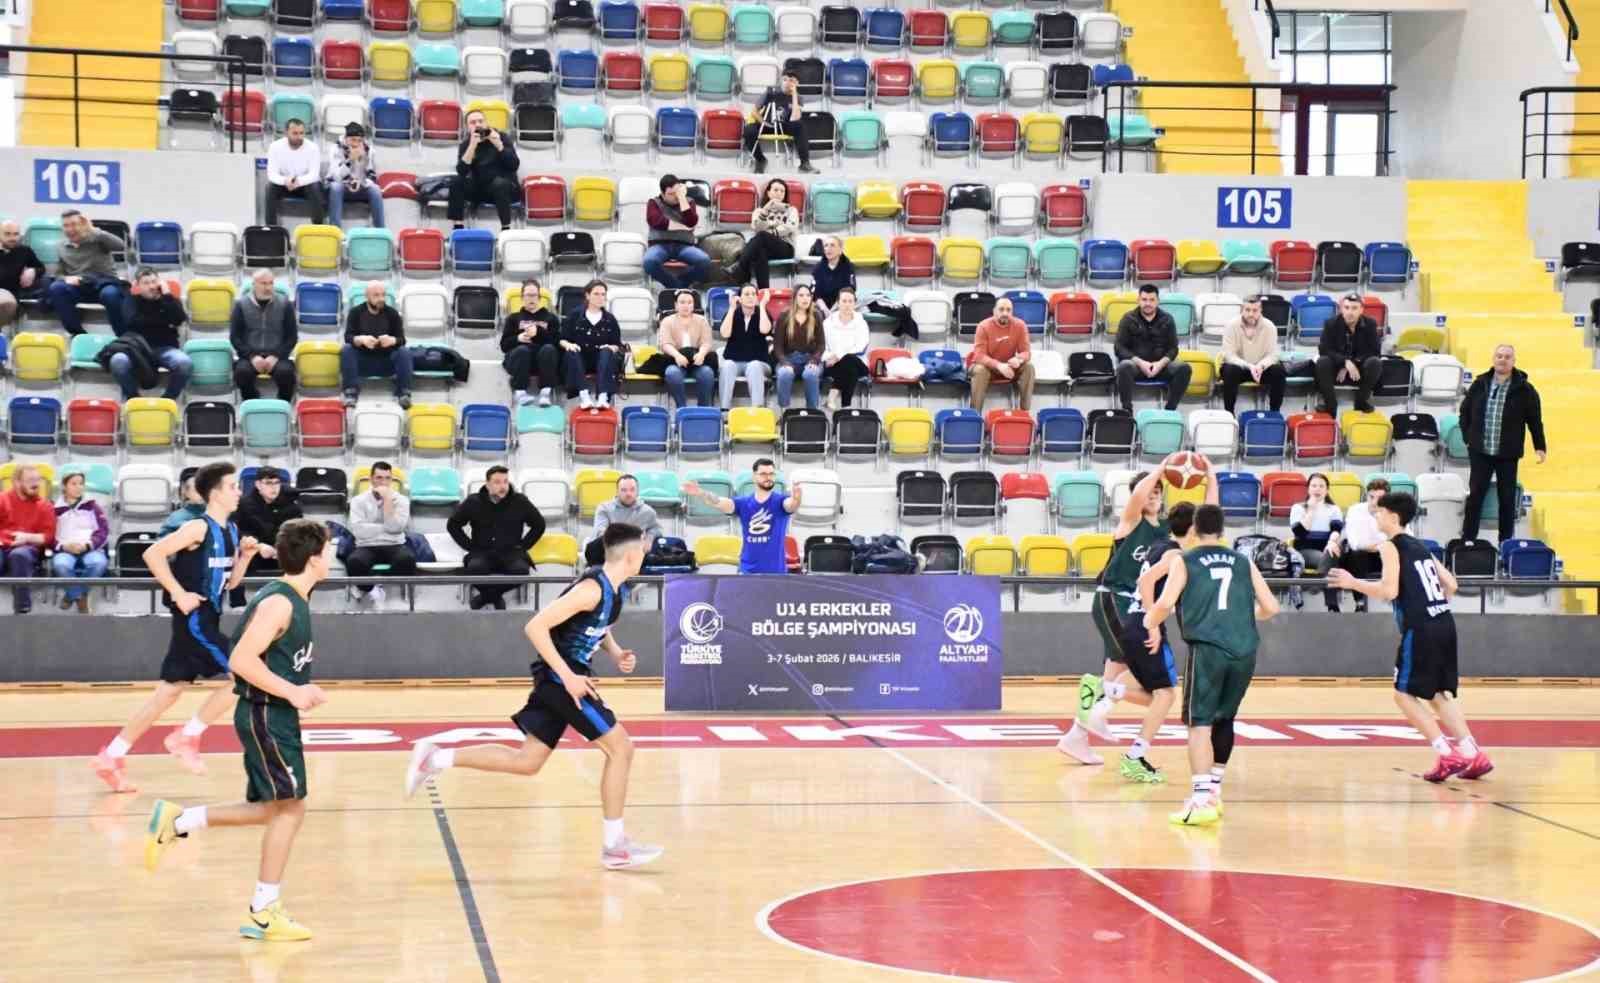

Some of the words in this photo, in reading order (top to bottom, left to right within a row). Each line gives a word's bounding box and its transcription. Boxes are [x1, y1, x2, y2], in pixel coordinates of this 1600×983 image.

[41, 163, 110, 201] 105
[1224, 189, 1282, 224] 105
[1209, 567, 1233, 610] 7
[1413, 558, 1446, 602] 18
[776, 602, 808, 617] U14
[810, 602, 892, 617] ERKEKLER
[751, 618, 805, 636] BÖLGE
[807, 619, 917, 639] ŞAMPİYONASI
[767, 653, 782, 664] 3-7
[785, 653, 814, 665] Şubat
[816, 653, 840, 664] 2026
[849, 652, 902, 664] BALIKESİR
[939, 644, 988, 655] ALTYAPI
